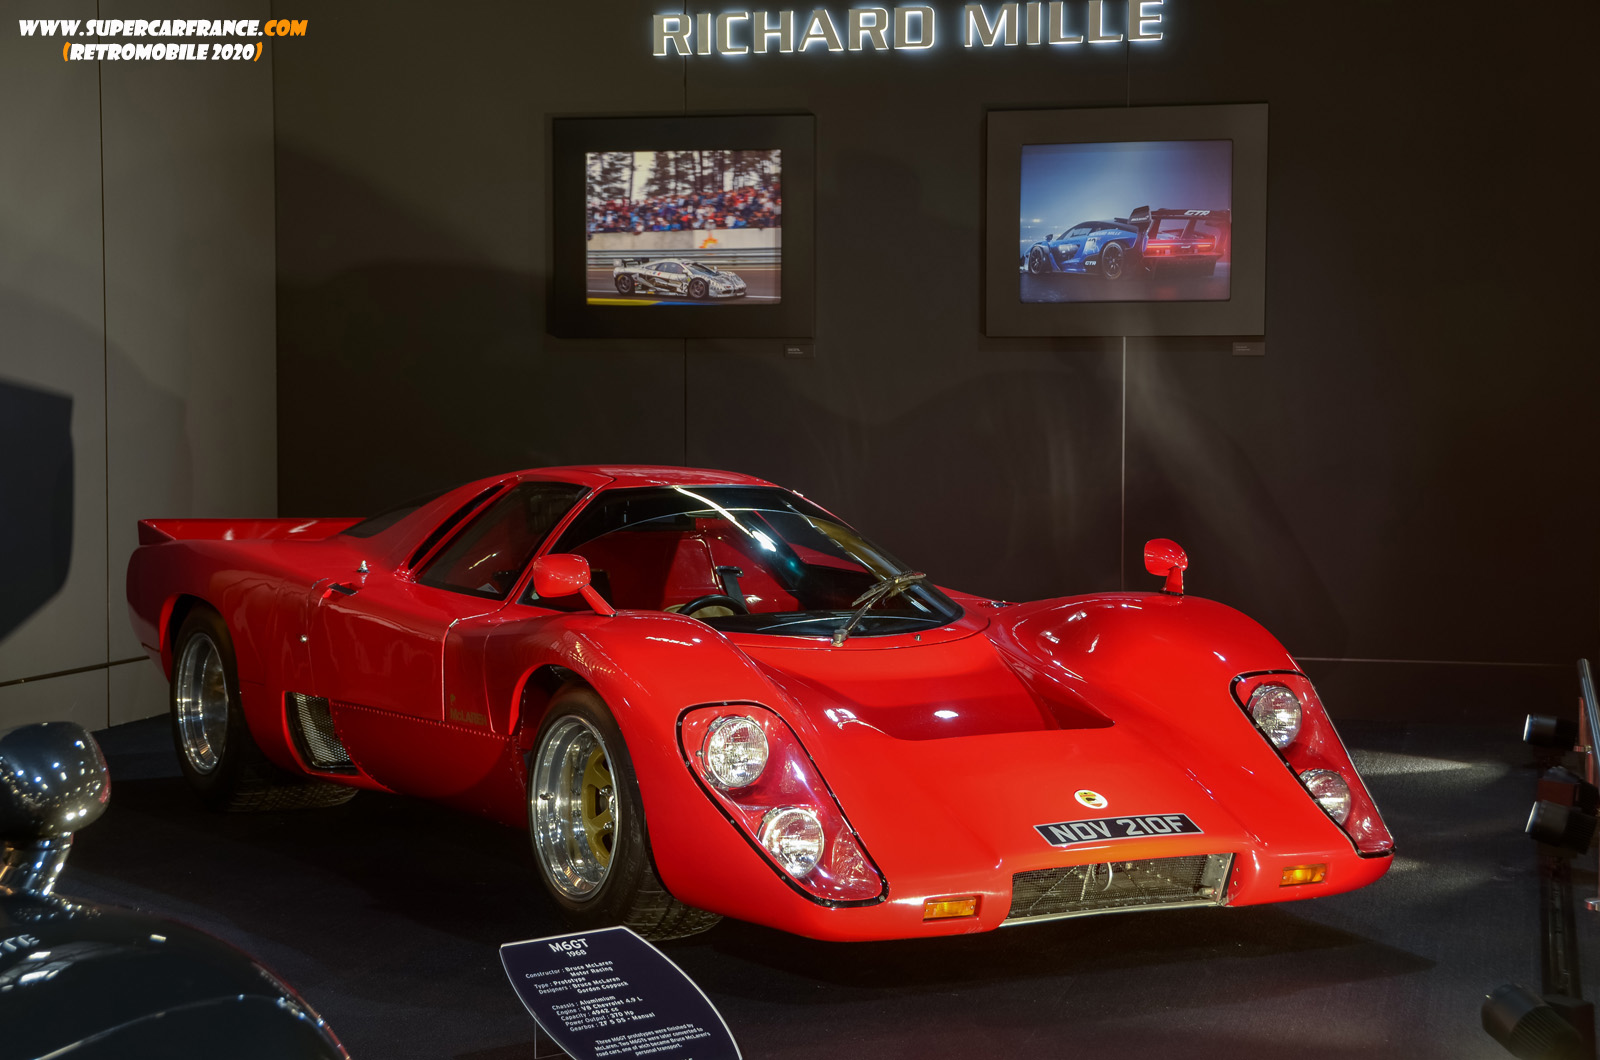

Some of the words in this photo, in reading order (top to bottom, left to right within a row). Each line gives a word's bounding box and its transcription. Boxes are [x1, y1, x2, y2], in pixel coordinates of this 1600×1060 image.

[652, 6, 935, 56] RICHARD
[964, 0, 1164, 48] MILLE
[1049, 821, 1112, 843] NDV
[1115, 816, 1185, 836] 210F
[548, 938, 588, 952] M6GT
[566, 949, 586, 957] 1968
[525, 969, 560, 978] Constructor
[585, 961, 613, 969] McLaren
[538, 986, 568, 994] Designers
[592, 977, 620, 985] McLaren
[553, 977, 586, 986] Prototype
[592, 1000, 624, 1009] Chevrolet
[560, 1013, 586, 1021] Capacity
[570, 1023, 594, 1032] Gearbox
[631, 1012, 655, 1021] Manual
[627, 1030, 654, 1040] prototypes
[672, 1028, 697, 1036] converted
[635, 1048, 657, 1056] personal
